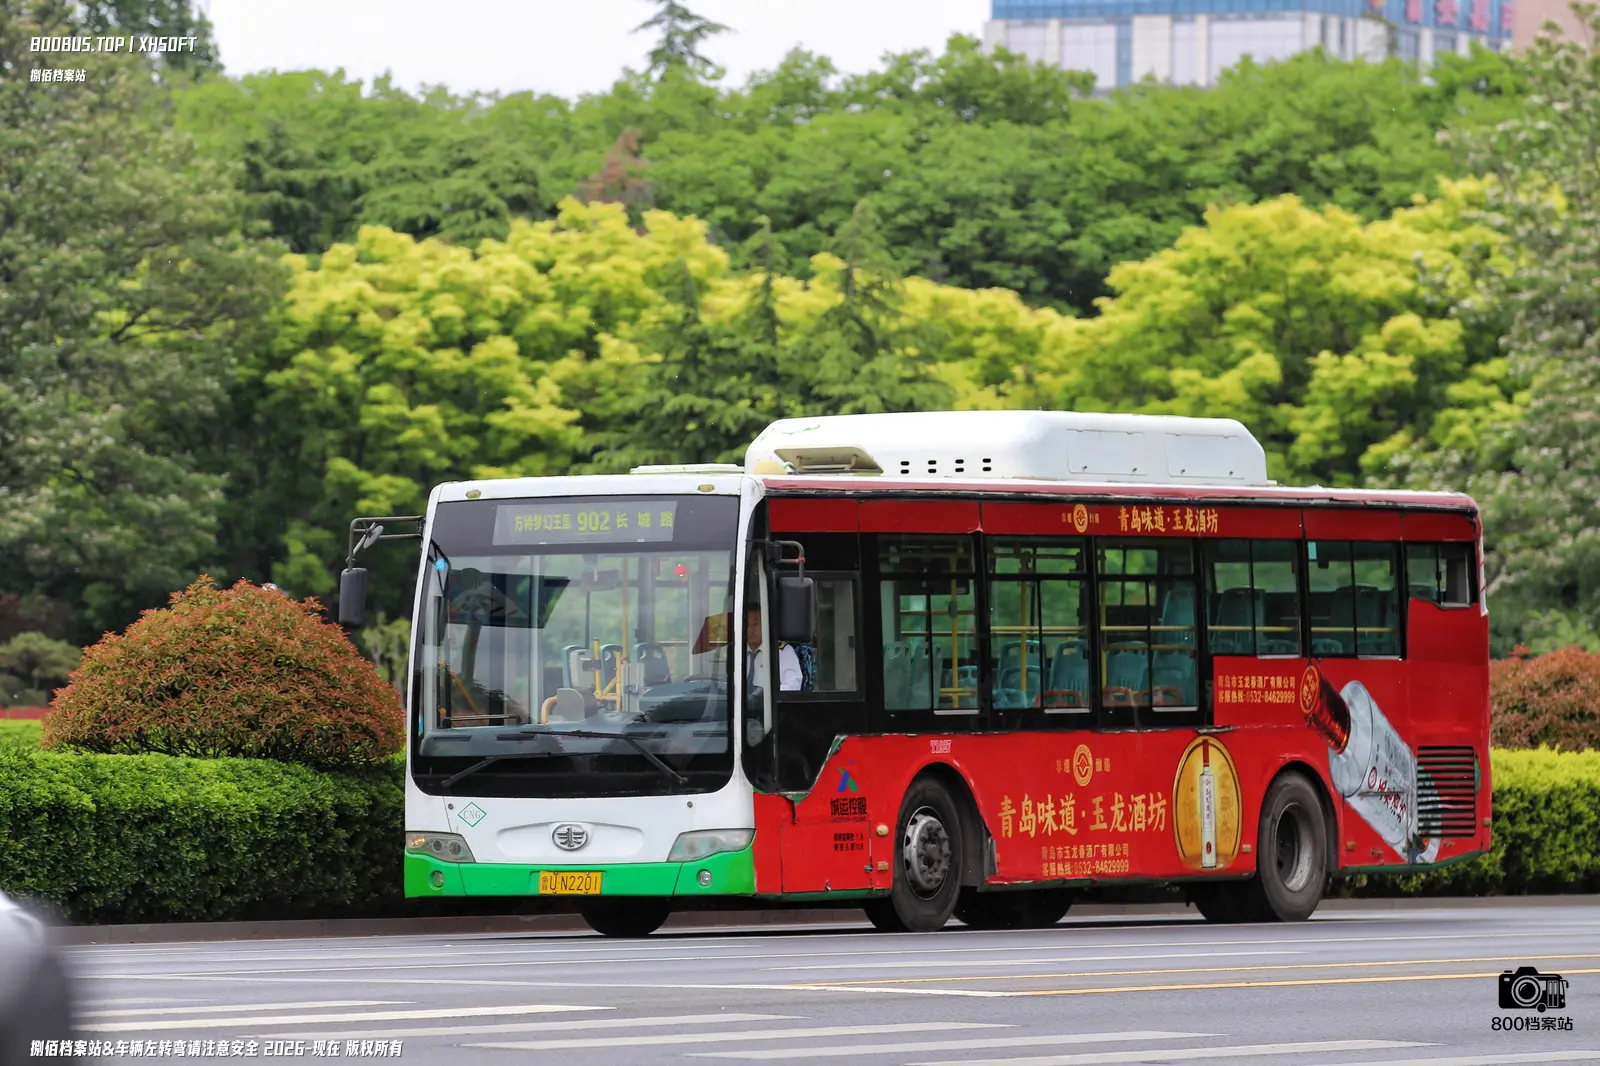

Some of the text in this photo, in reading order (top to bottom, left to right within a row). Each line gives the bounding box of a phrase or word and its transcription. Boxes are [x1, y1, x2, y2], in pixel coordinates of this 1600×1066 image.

[577, 511, 611, 532] 902
[1118, 506, 1218, 533] 青岛味道·玉龙酒坊
[463, 810, 481, 820] CNG
[830, 796, 867, 815] 城运控股
[997, 792, 1167, 838] 青岛味道·玉龙酒坊
